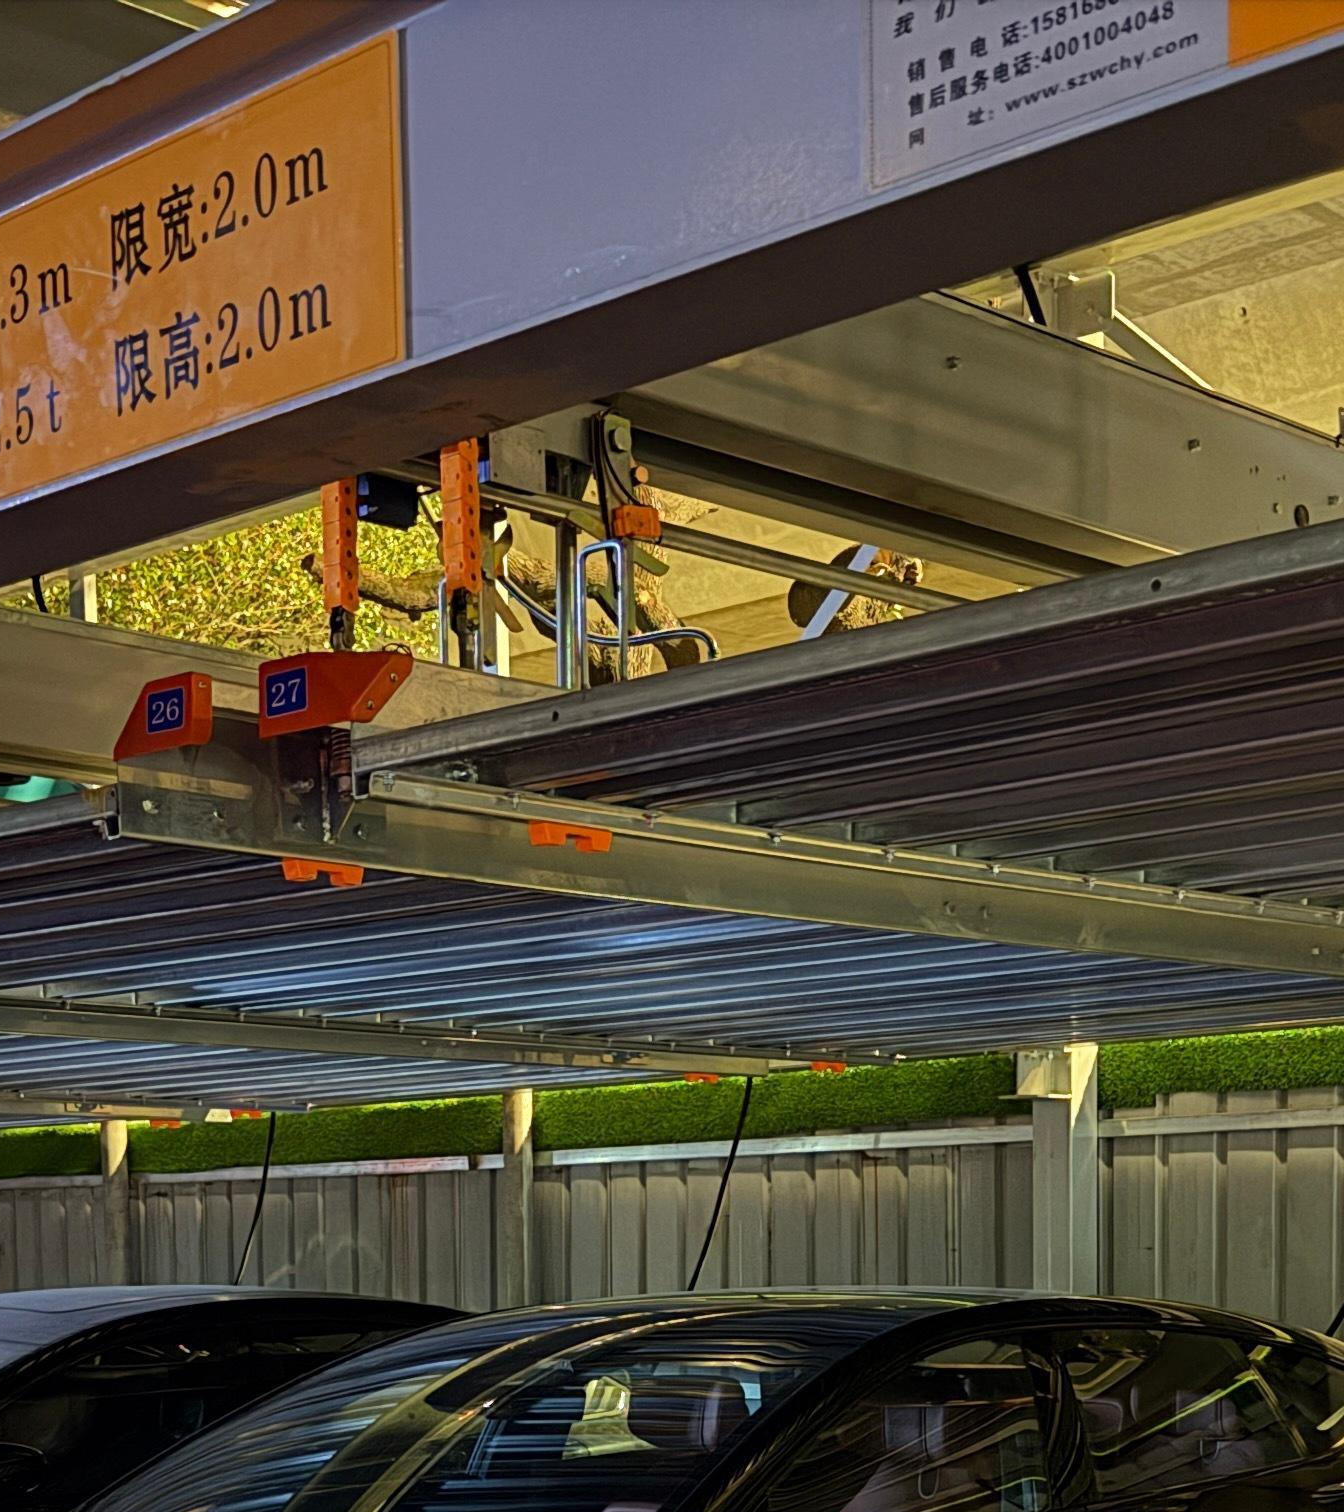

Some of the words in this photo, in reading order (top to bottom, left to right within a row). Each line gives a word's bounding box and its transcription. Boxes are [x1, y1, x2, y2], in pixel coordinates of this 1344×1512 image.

[1005, 33, 1199, 112] www.szwchy.com
[110, 146, 329, 292] 限宽:2.0m
[113, 282, 332, 417] 限高:2.0m
[151, 697, 180, 725] 26
[271, 678, 302, 708] 27
